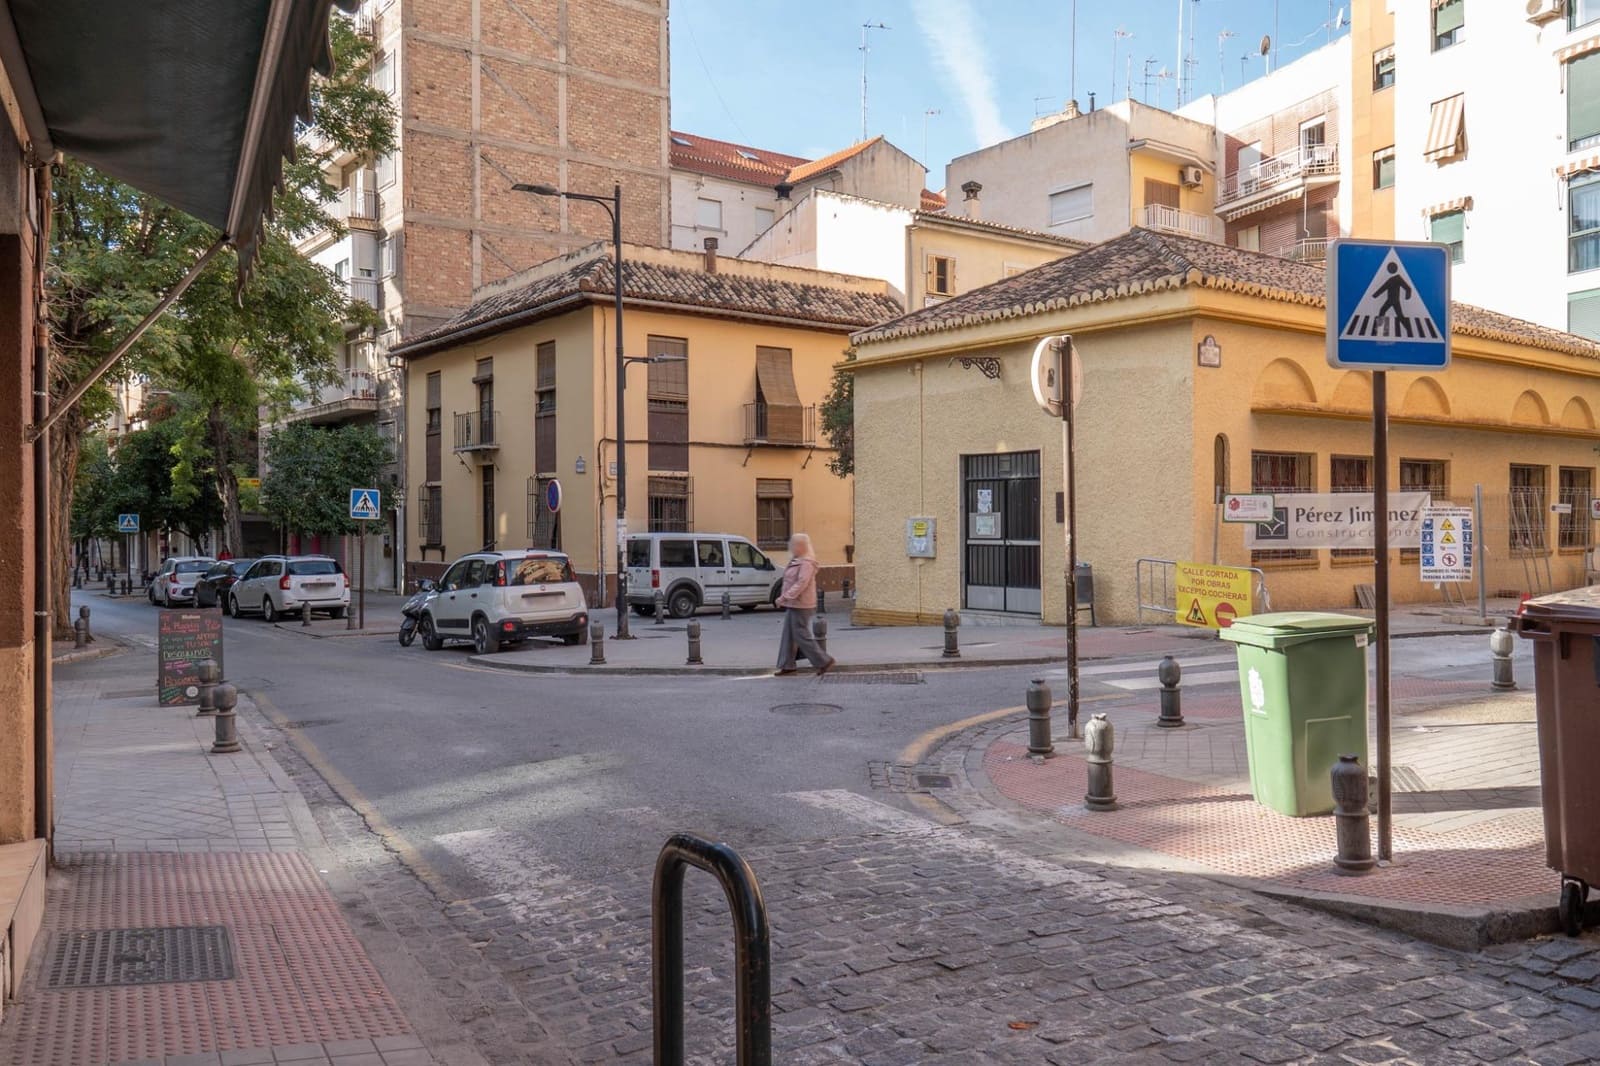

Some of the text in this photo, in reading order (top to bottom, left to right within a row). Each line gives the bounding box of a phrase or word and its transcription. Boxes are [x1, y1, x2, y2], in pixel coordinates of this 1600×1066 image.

[1296, 507, 1418, 525] Pérez Jimnez
[1295, 527, 1419, 538] Construccnes
[1183, 568, 1239, 580] CALLE CORTADA
[1191, 578, 1231, 588] POR OBRAS
[1178, 585, 1247, 600] EXCEPTO COCHERAS
